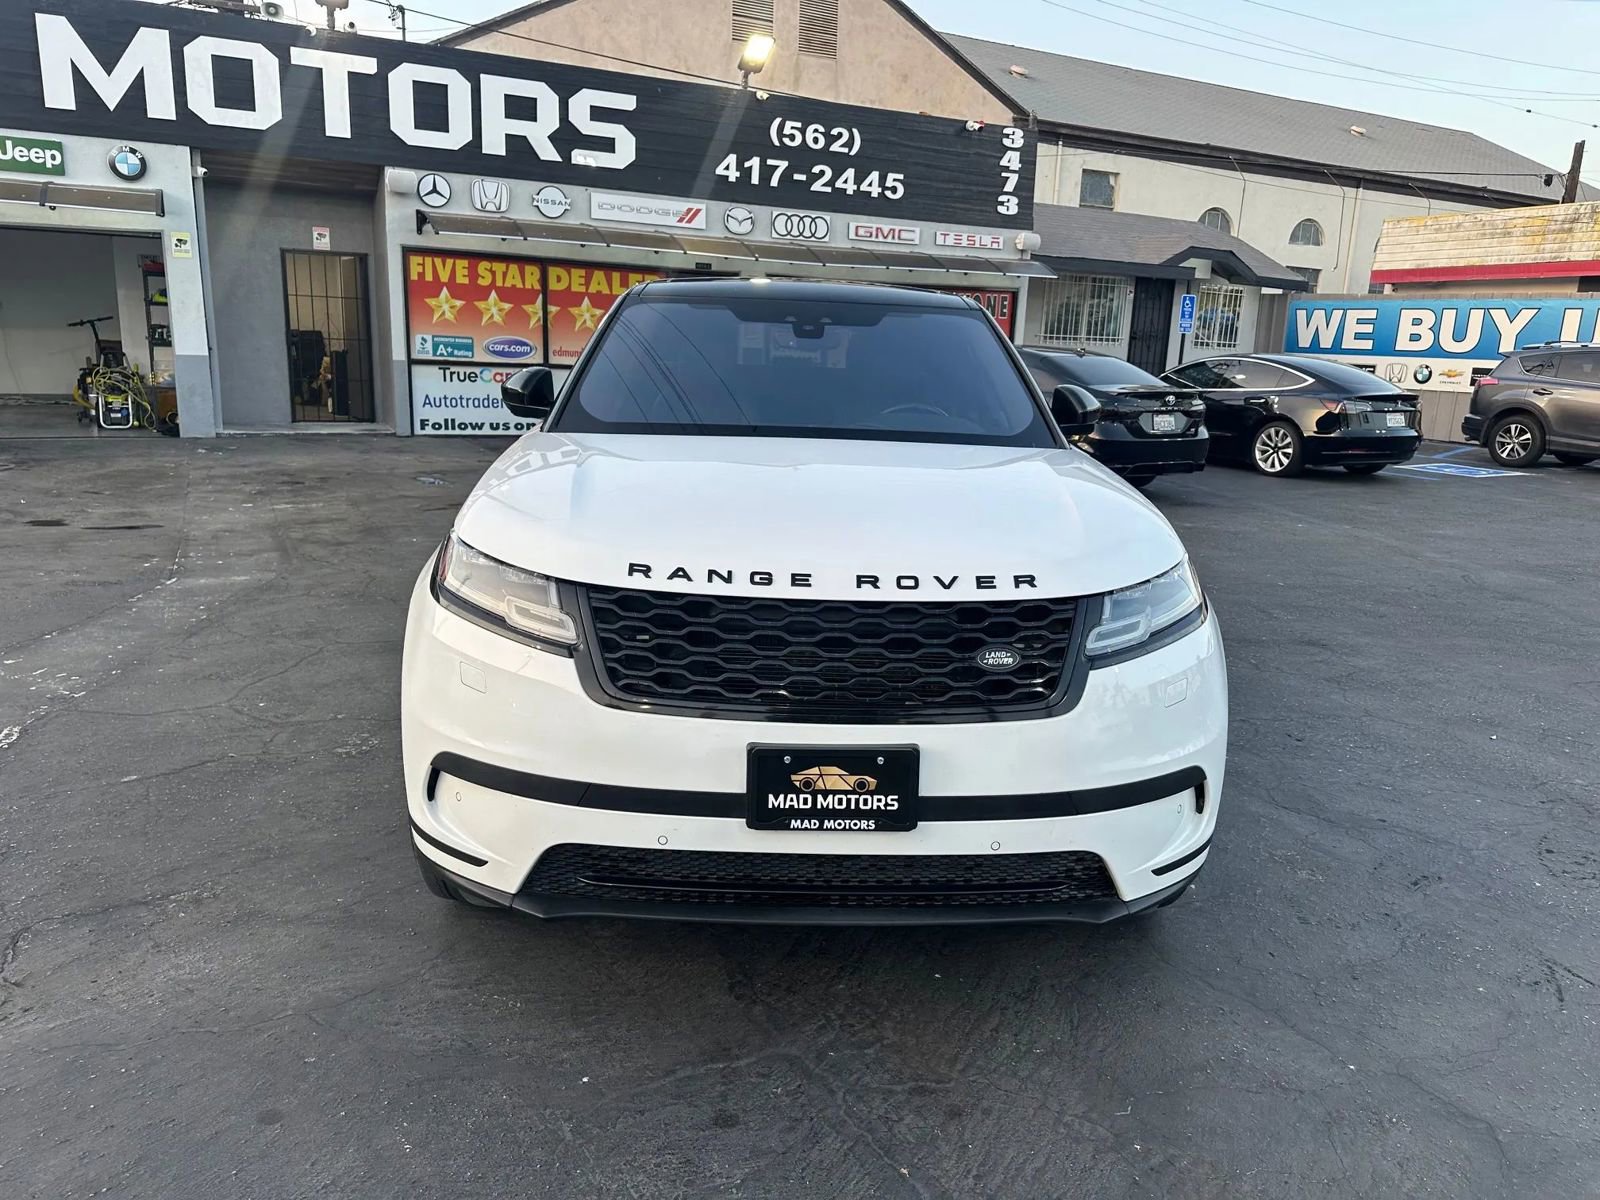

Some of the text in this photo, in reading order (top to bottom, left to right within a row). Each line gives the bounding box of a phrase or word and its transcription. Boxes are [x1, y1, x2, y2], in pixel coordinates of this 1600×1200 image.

[34, 12, 637, 170] MOTORS
[769, 117, 861, 156] (562)
[0, 140, 62, 168] Jeep
[715, 153, 905, 200] 417-2445
[532, 198, 571, 207] NISSAN
[598, 202, 688, 217] DODGE
[854, 225, 916, 242] GMC
[940, 232, 1001, 248] TESLA
[409, 255, 660, 295] FIVE STAR DEALE
[1295, 308, 1378, 350] WE
[1394, 308, 1541, 354] BUY
[436, 344, 453, 356] A+
[488, 343, 531, 353] cars.com
[419, 418, 485, 431] Follow
[489, 422, 511, 431] us
[628, 562, 1038, 590] RANGE ROVER
[768, 794, 899, 811] MAD MOTORS
[790, 819, 876, 830] MAD MOTORS
